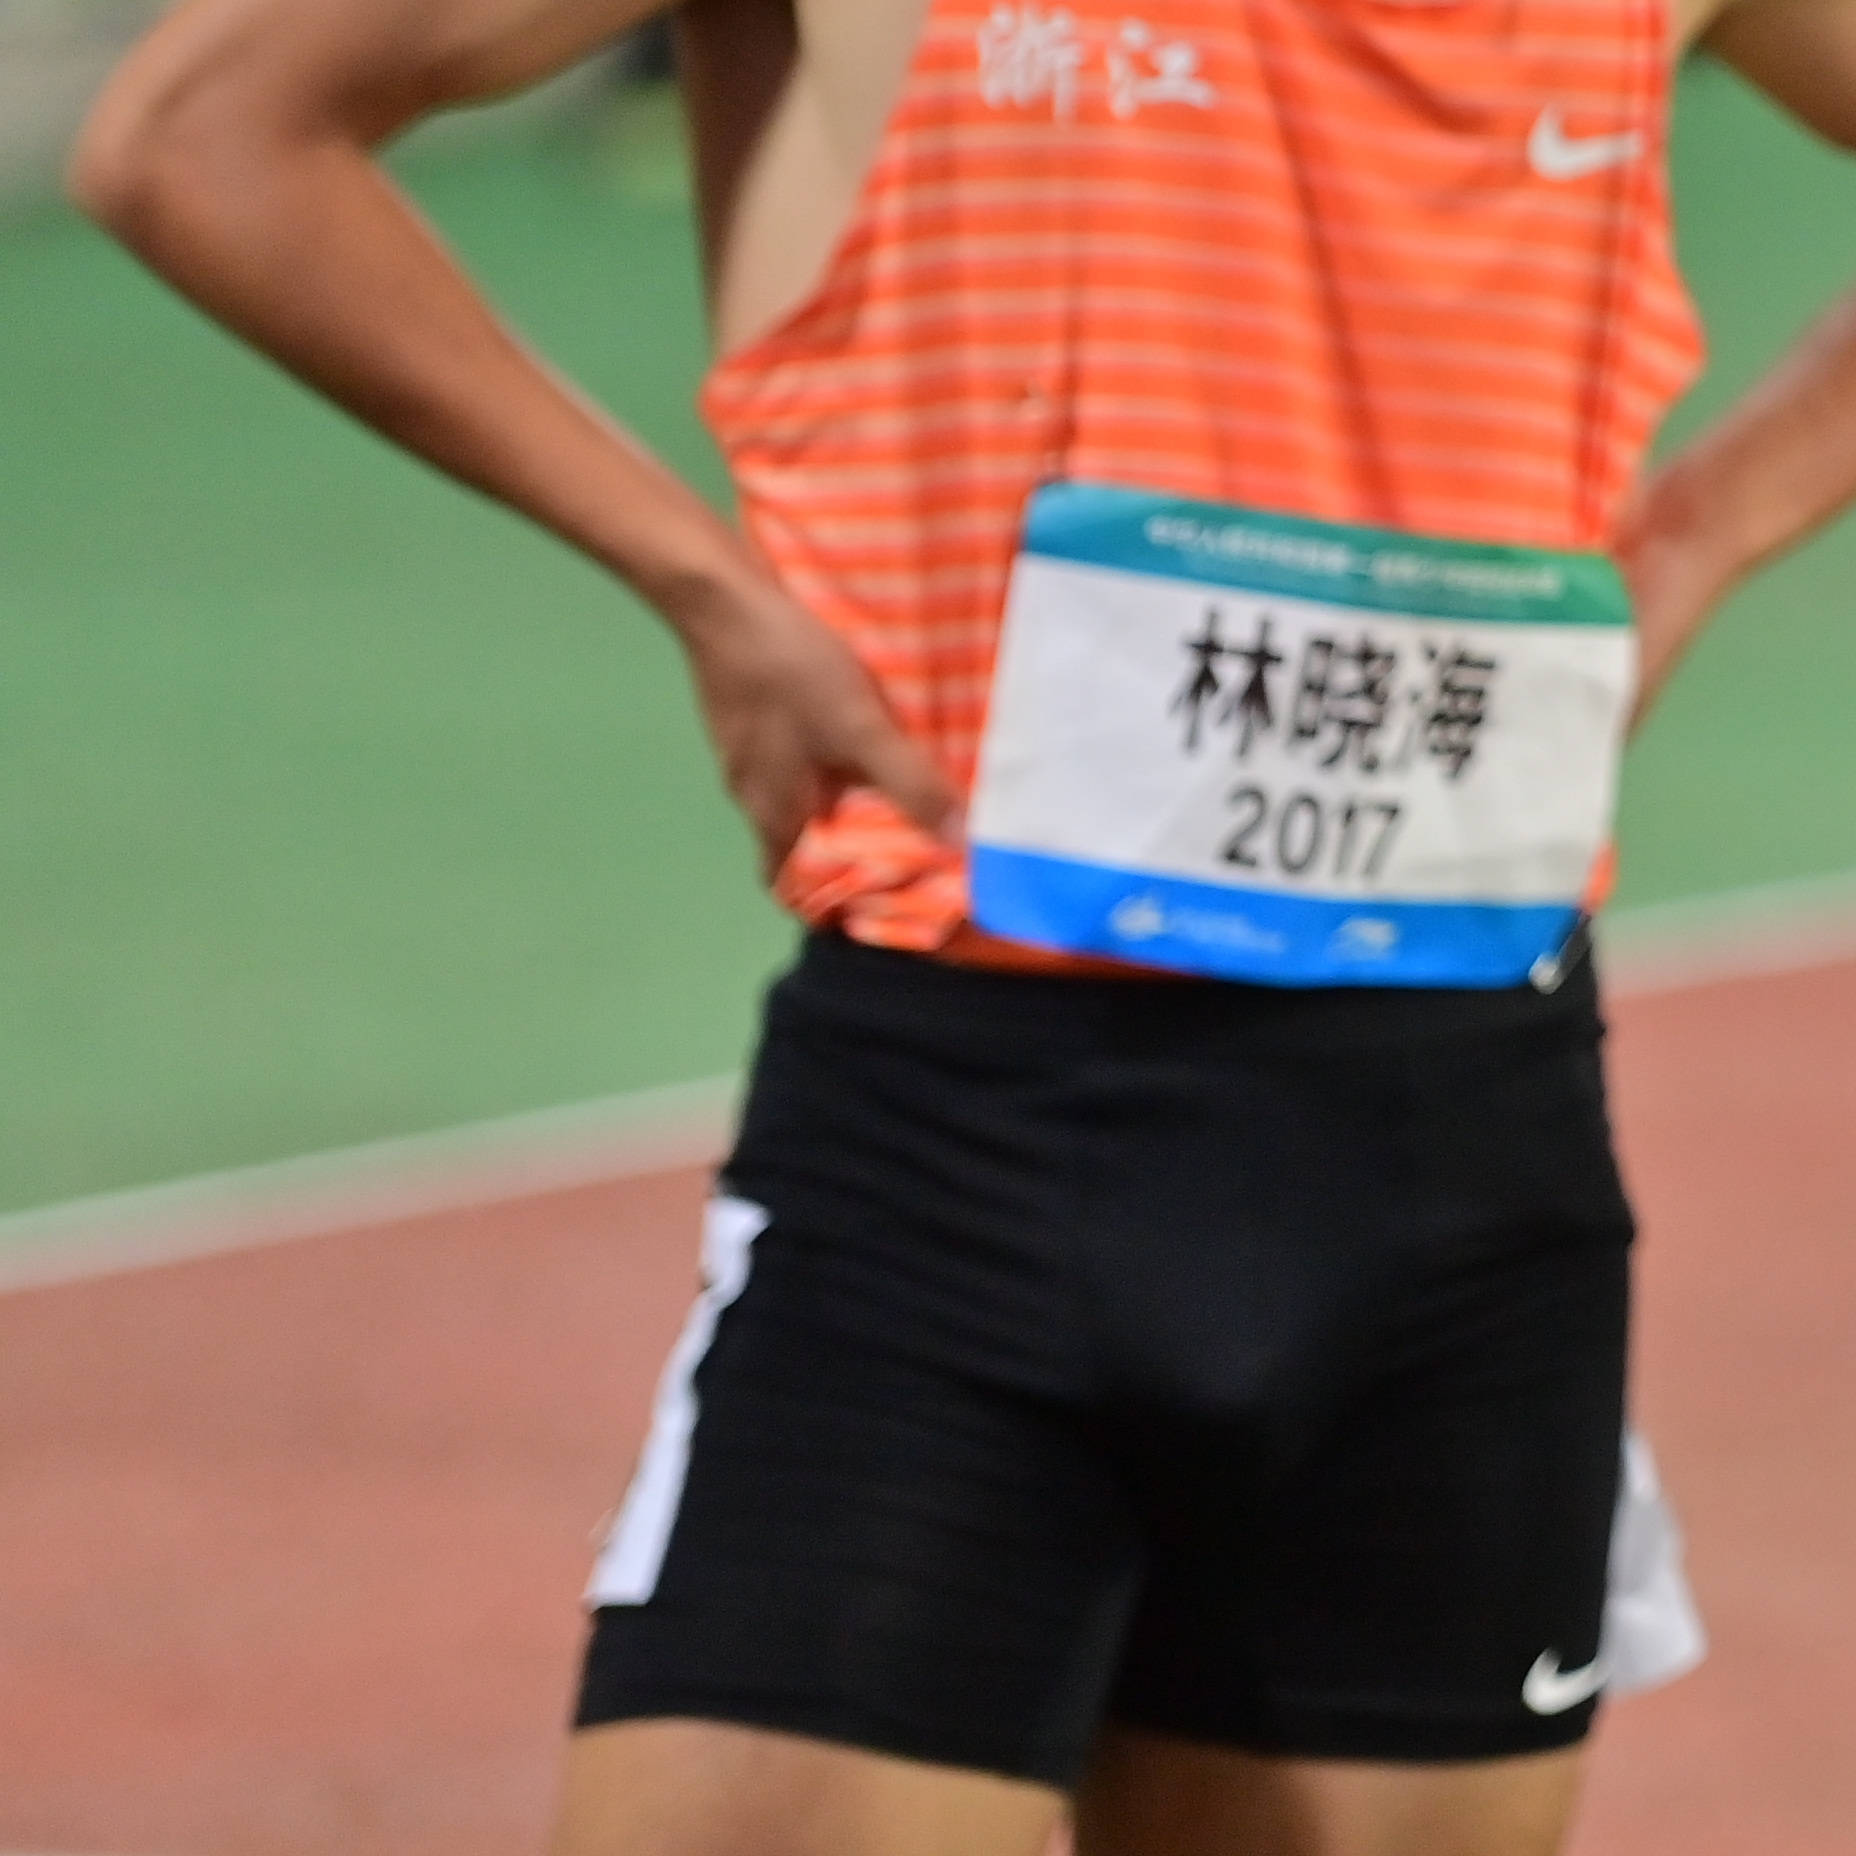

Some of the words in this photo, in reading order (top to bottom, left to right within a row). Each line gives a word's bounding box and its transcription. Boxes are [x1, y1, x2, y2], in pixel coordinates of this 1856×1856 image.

[977, 1, 1217, 127] 浙江
[1168, 604, 1498, 781] 林晓海
[1221, 784, 1404, 881] 2017
